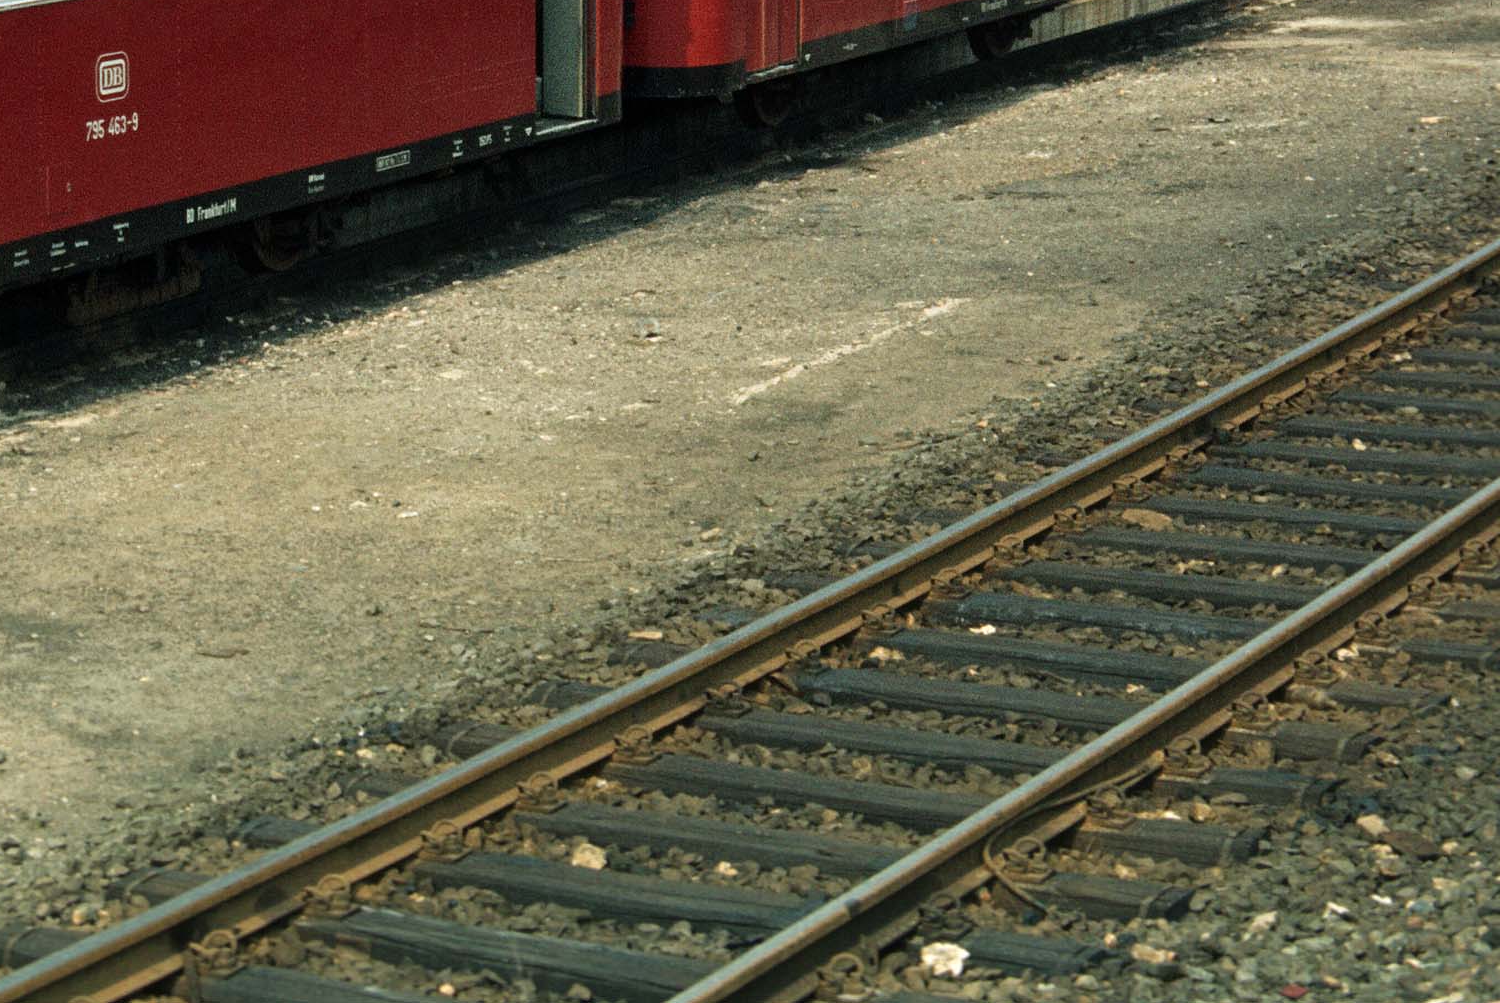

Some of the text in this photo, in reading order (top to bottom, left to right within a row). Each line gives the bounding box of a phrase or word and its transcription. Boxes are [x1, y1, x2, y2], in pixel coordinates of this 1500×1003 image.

[103, 66, 123, 88] DB
[85, 111, 139, 142] 795 463-9
